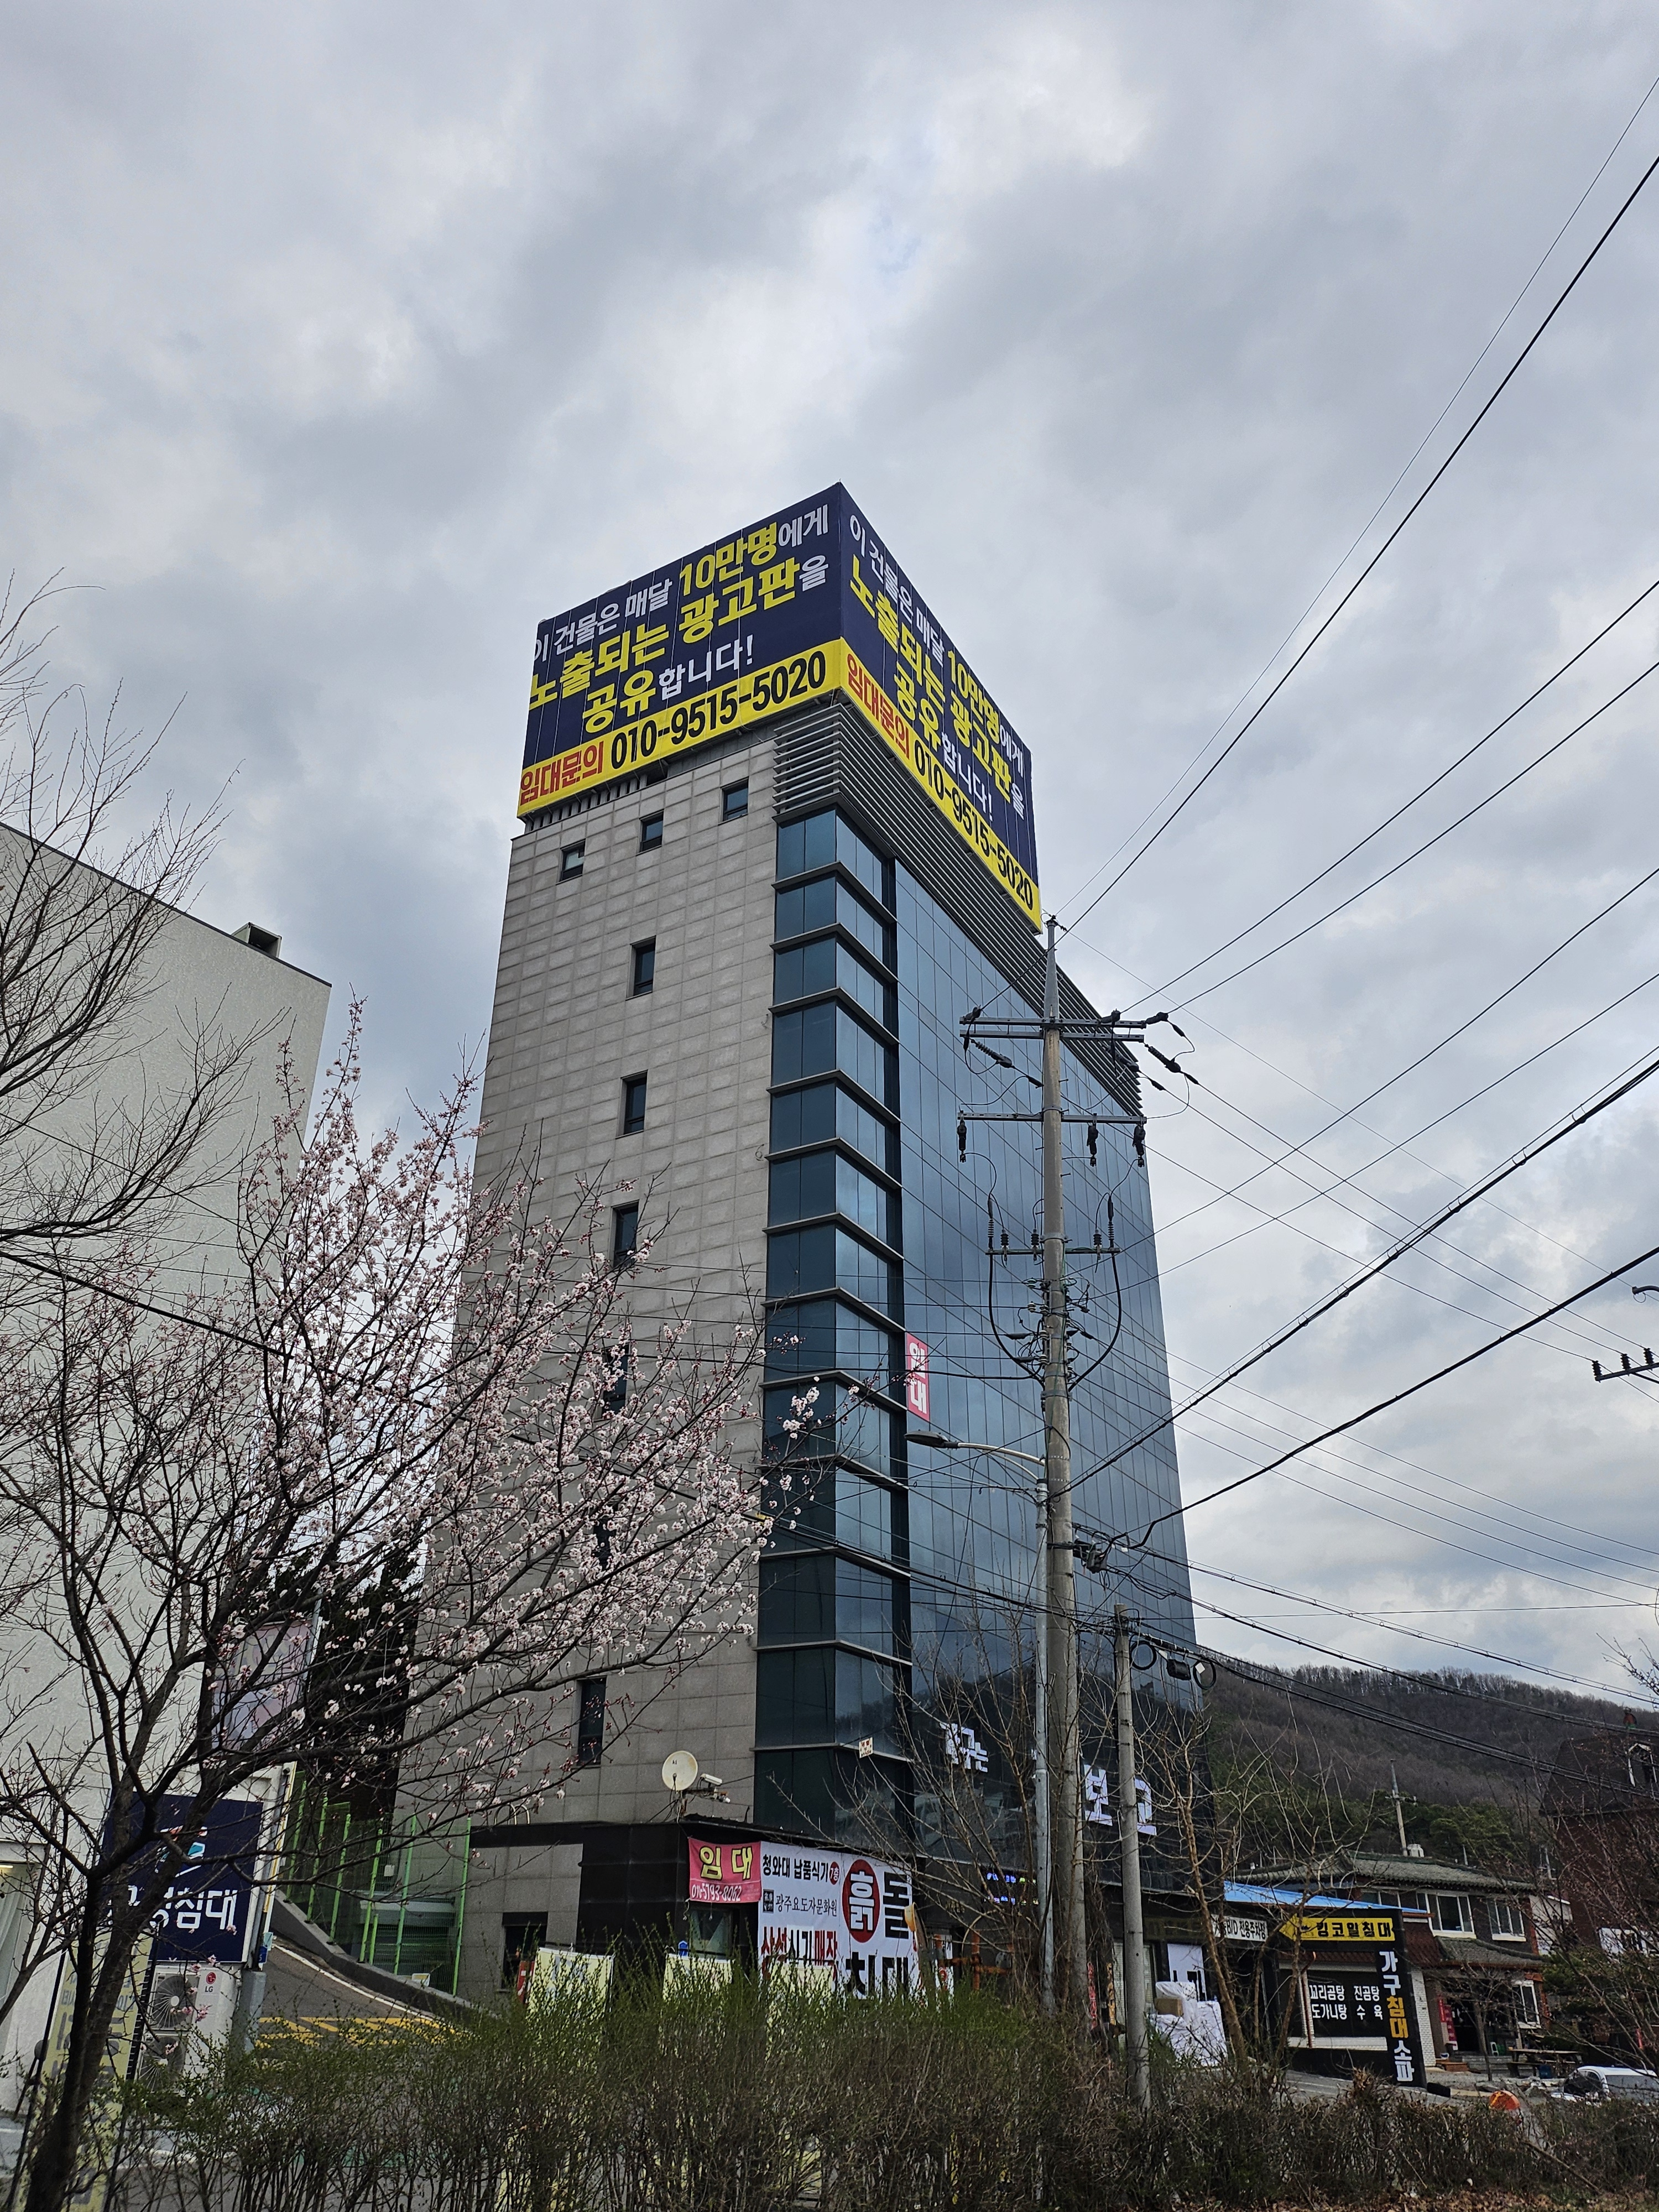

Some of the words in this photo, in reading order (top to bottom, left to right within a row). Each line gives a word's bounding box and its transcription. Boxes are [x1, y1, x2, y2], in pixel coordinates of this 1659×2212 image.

[535, 634, 549, 662] 이
[554, 603, 619, 655] 건물은
[625, 579, 672, 618] 매달
[679, 504, 828, 596] 10만명에게
[529, 623, 669, 710] 노출되는
[679, 555, 828, 643] 광고판을
[850, 514, 865, 558] 이
[869, 539, 914, 624] 건물은
[916, 606, 945, 668] 매달
[948, 650, 1023, 778] 10만명에게
[583, 635, 753, 733] 공유합니다!
[850, 554, 946, 714] 노출되는
[951, 690, 1024, 820] 광고판을
[520, 741, 604, 806] 임대문의
[611, 650, 826, 769] 010-9515-5020
[894, 661, 993, 822] 공유합니다!
[847, 654, 910, 760] 임대문의
[915, 739, 1033, 910] 010-9515-5020
[909, 1342, 927, 1414] 임대
[700, 1846, 753, 1880] 임대
[763, 1854, 790, 1878] 청와대
[794, 1858, 828, 1882] 납품식기
[1239, 1921, 1266, 1939] 전용주차장
[1309, 1985, 1345, 2001] 꼬리곰탕
[1354, 1986, 1380, 2001] 진곰탕
[1379, 1951, 1401, 1996] 가구
[1311, 2004, 1347, 2020] 도가니탕
[1387, 1996, 1408, 2038] 침대
[1394, 2040, 1415, 2081] 소파
